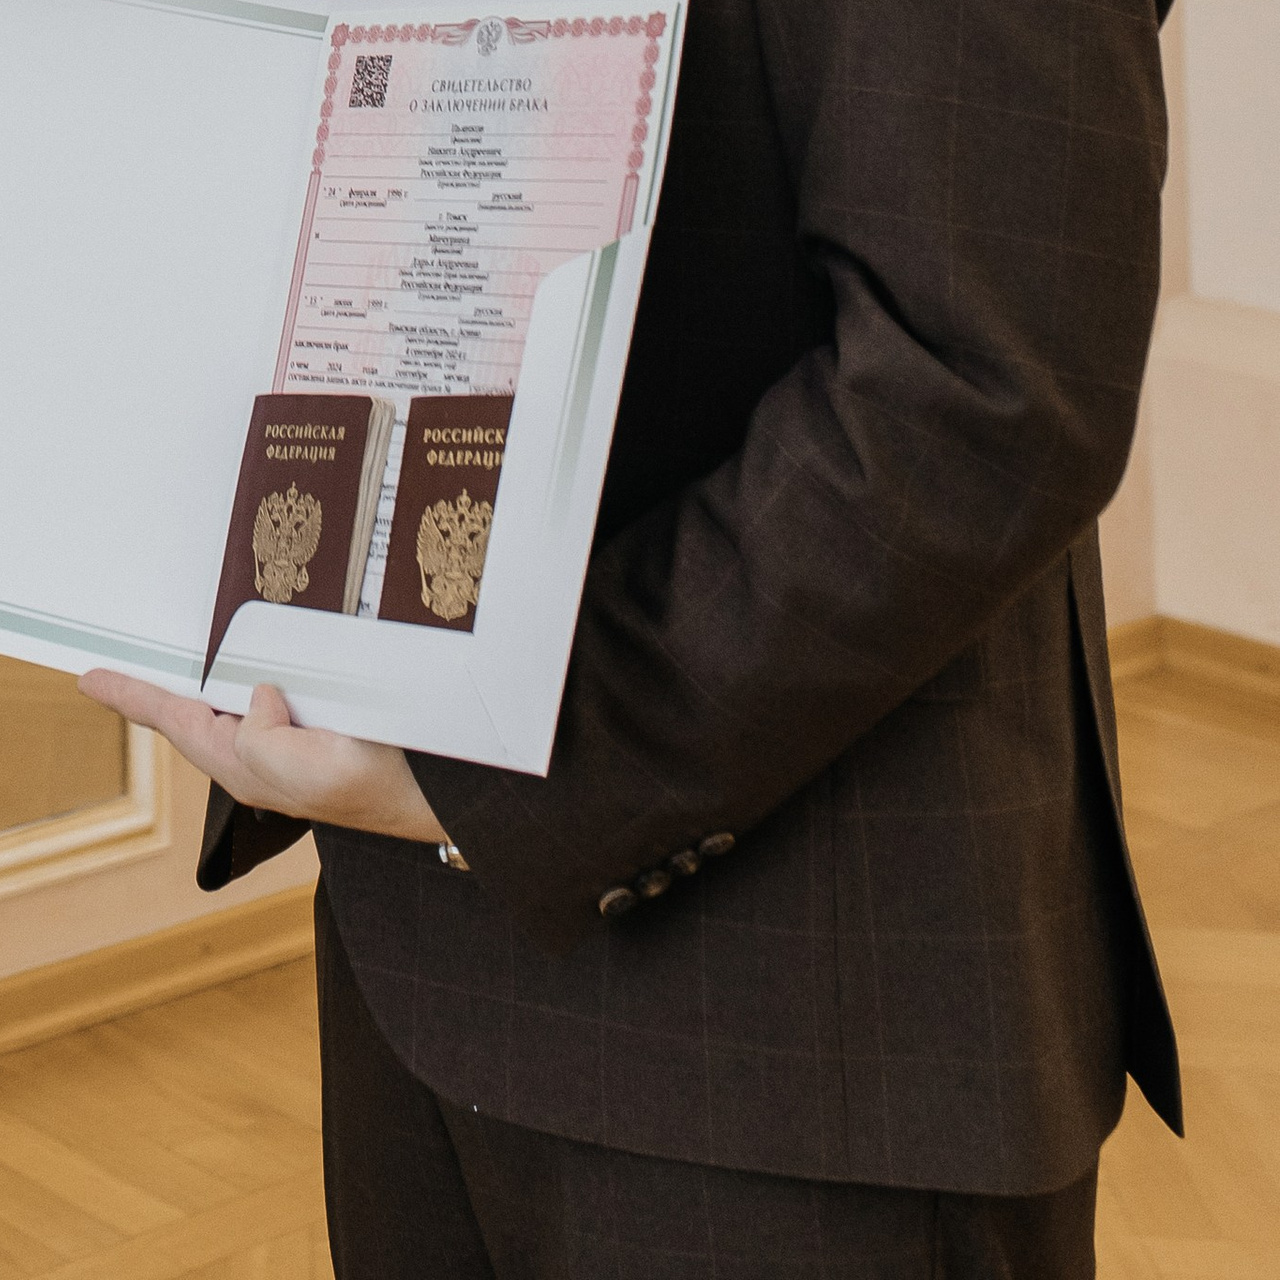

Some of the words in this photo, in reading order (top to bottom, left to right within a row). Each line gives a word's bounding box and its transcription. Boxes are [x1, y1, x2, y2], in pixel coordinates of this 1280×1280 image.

[431, 78, 532, 94] СВИДЕТЕЛЬСТВО
[409, 99, 418, 112] О
[421, 98, 506, 112] ЗАКЛЮЧЕНИИ
[509, 97, 549, 112] БРАКА
[265, 423, 346, 440] РОССИЙСКАЯ
[423, 426, 505, 444] РОССИЙСК
[266, 445, 336, 463] ФЕДЕРАЦИЯ
[426, 449, 503, 470] ФЕДЕРАЦИ
